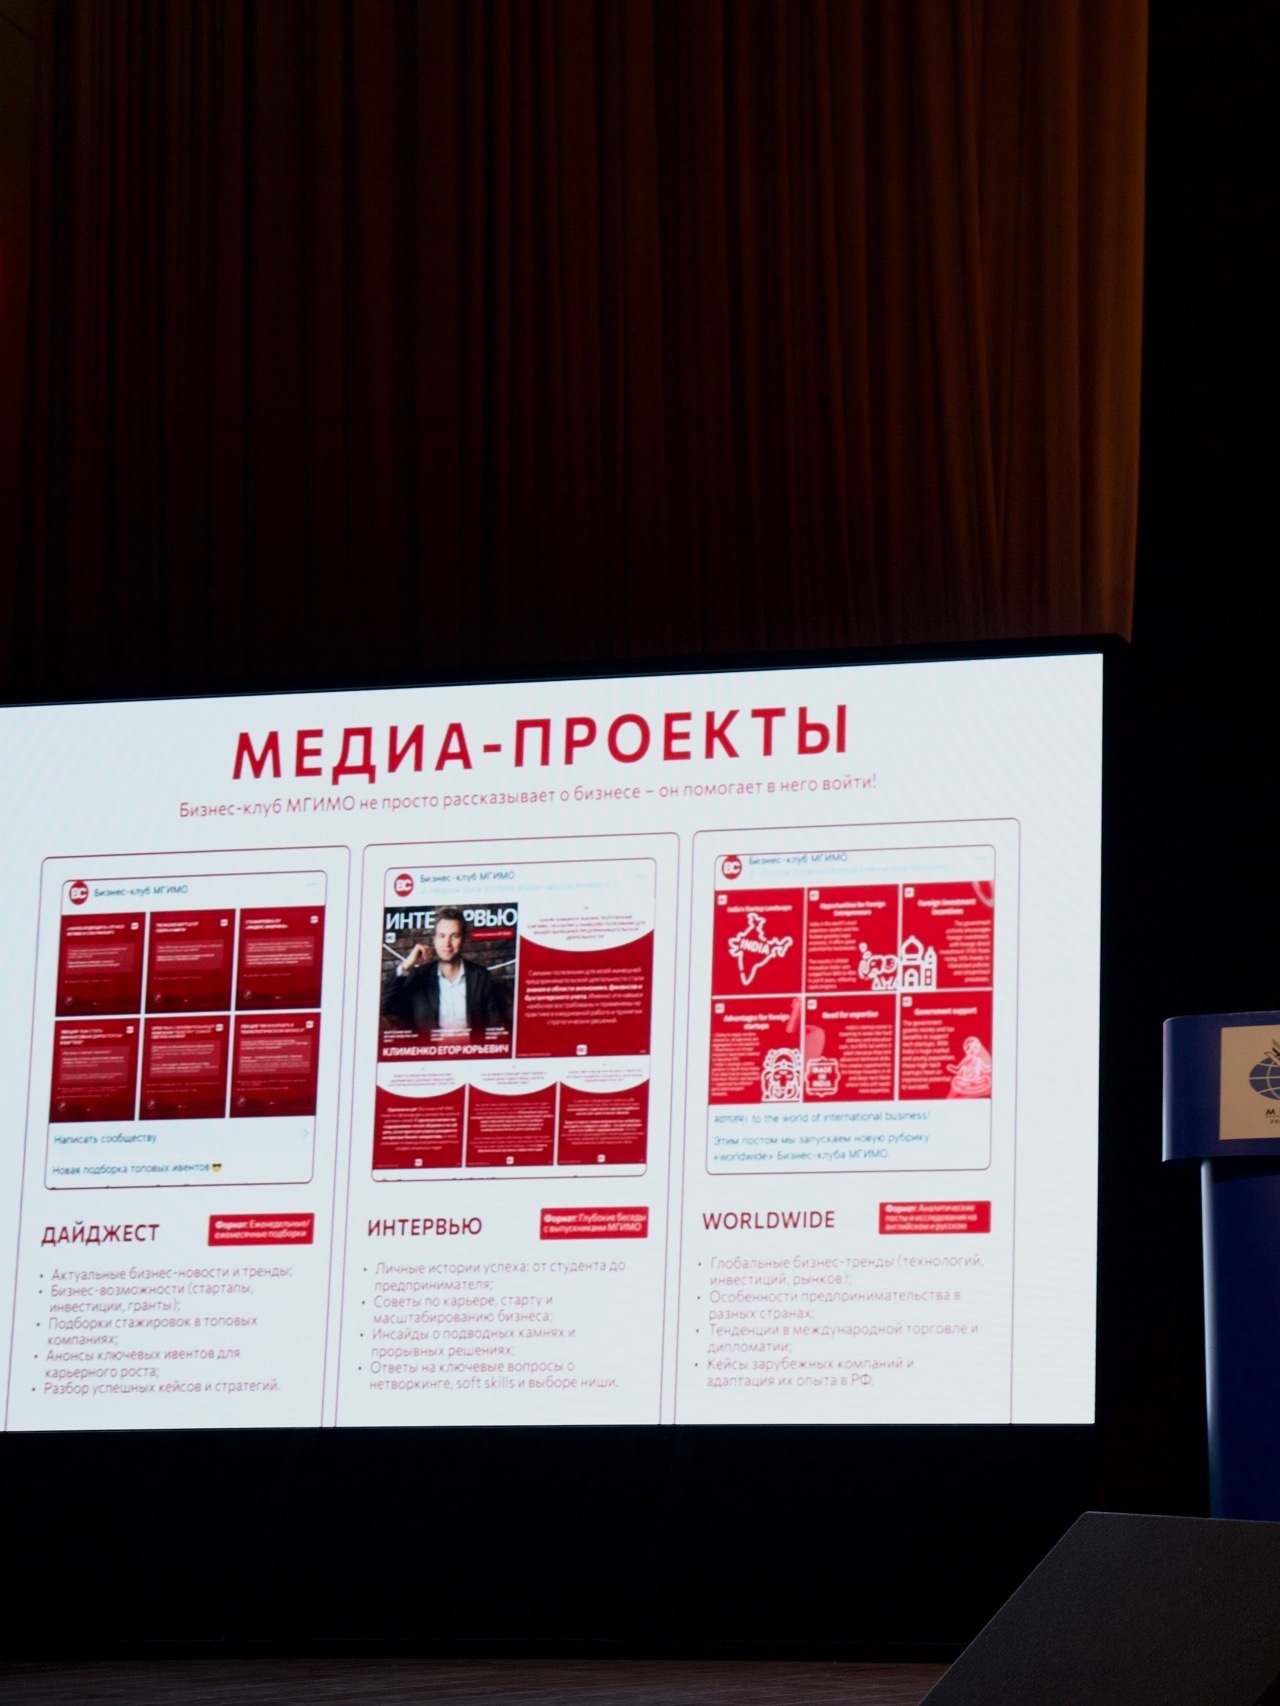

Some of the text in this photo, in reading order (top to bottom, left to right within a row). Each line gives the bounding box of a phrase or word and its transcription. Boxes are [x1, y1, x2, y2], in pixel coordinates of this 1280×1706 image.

[232, 704, 847, 785] МЕДИА-ПРОЕКТЫ
[179, 774, 876, 818] Бизнес-клуб МГИМО не просто рассказывает о бизнесе он помогает в него войти!
[748, 852, 848, 866] Бизнес-клуб МГИМО
[419, 870, 515, 884] Бизнес-клуб МГИМО
[93, 884, 189, 899] Бизнес-клуб МГИМО
[739, 938, 771, 955] INDIA
[382, 1043, 509, 1058] КЛИМЕНКО ЕГОР ЮРЬЕВИЧ
[751, 1114, 761, 1124] to
[763, 1114, 780, 1124] the
[782, 1112, 809, 1123] world
[811, 1112, 821, 1123] of
[823, 1111, 883, 1122] international
[53, 1131, 157, 1145] Написать сообществу
[52, 1163, 211, 1176] Новая подборка топовых ивентов
[367, 1217, 482, 1237] ИНТЕРВЬЮ
[702, 1211, 835, 1230] WORLDWIDE
[41, 1221, 160, 1246] ДАЙДЖЕСТ
[375, 1261, 426, 1275] Личные
[428, 1263, 481, 1275] истории
[532, 1262, 547, 1273] от
[549, 1261, 607, 1274] студента
[608, 1261, 626, 1272] до
[710, 1254, 790, 1270] Глобальные
[792, 1254, 894, 1269] бизнес-тренды
[51, 1268, 127, 1282] Актуальные
[128, 1265, 230, 1280] бизнес-новости
[232, 1269, 240, 1277] и
[50, 1282, 185, 1298] Бизнес-возможности
[709, 1289, 961, 1304] Особенности предпринимательства в
[373, 1293, 422, 1309] Советы
[424, 1296, 441, 1307] по
[500, 1295, 543, 1308] старту
[545, 1296, 553, 1305] и
[373, 1309, 495, 1325] масштабированию
[708, 1309, 756, 1321] разных
[48, 1315, 257, 1331] Подборки стажировок в топовых
[709, 1322, 979, 1337] Тенденции в международной торговле и
[372, 1327, 576, 1341] Инсайды о подводных камнях и
[46, 1348, 241, 1362] Анонсы ключевых ивентов для
[371, 1347, 445, 1359] прорывных
[369, 1360, 575, 1375] Ответы на ключевые вопросы о
[707, 1355, 914, 1371] Кейсы зарубежных компаний и
[44, 1367, 118, 1381] карьерного
[706, 1376, 775, 1388] адаптация
[778, 1377, 793, 1387] их
[796, 1375, 838, 1387] опыта
[840, 1376, 848, 1386] в
[43, 1380, 90, 1396] Разбор
[92, 1383, 155, 1395] успешных
[158, 1379, 202, 1394] кейсов
[204, 1383, 212, 1392] и
[456, 1376, 482, 1390] soft
[484, 1375, 515, 1390] skills
[517, 1379, 526, 1388] и
[528, 1374, 578, 1389] выборе
